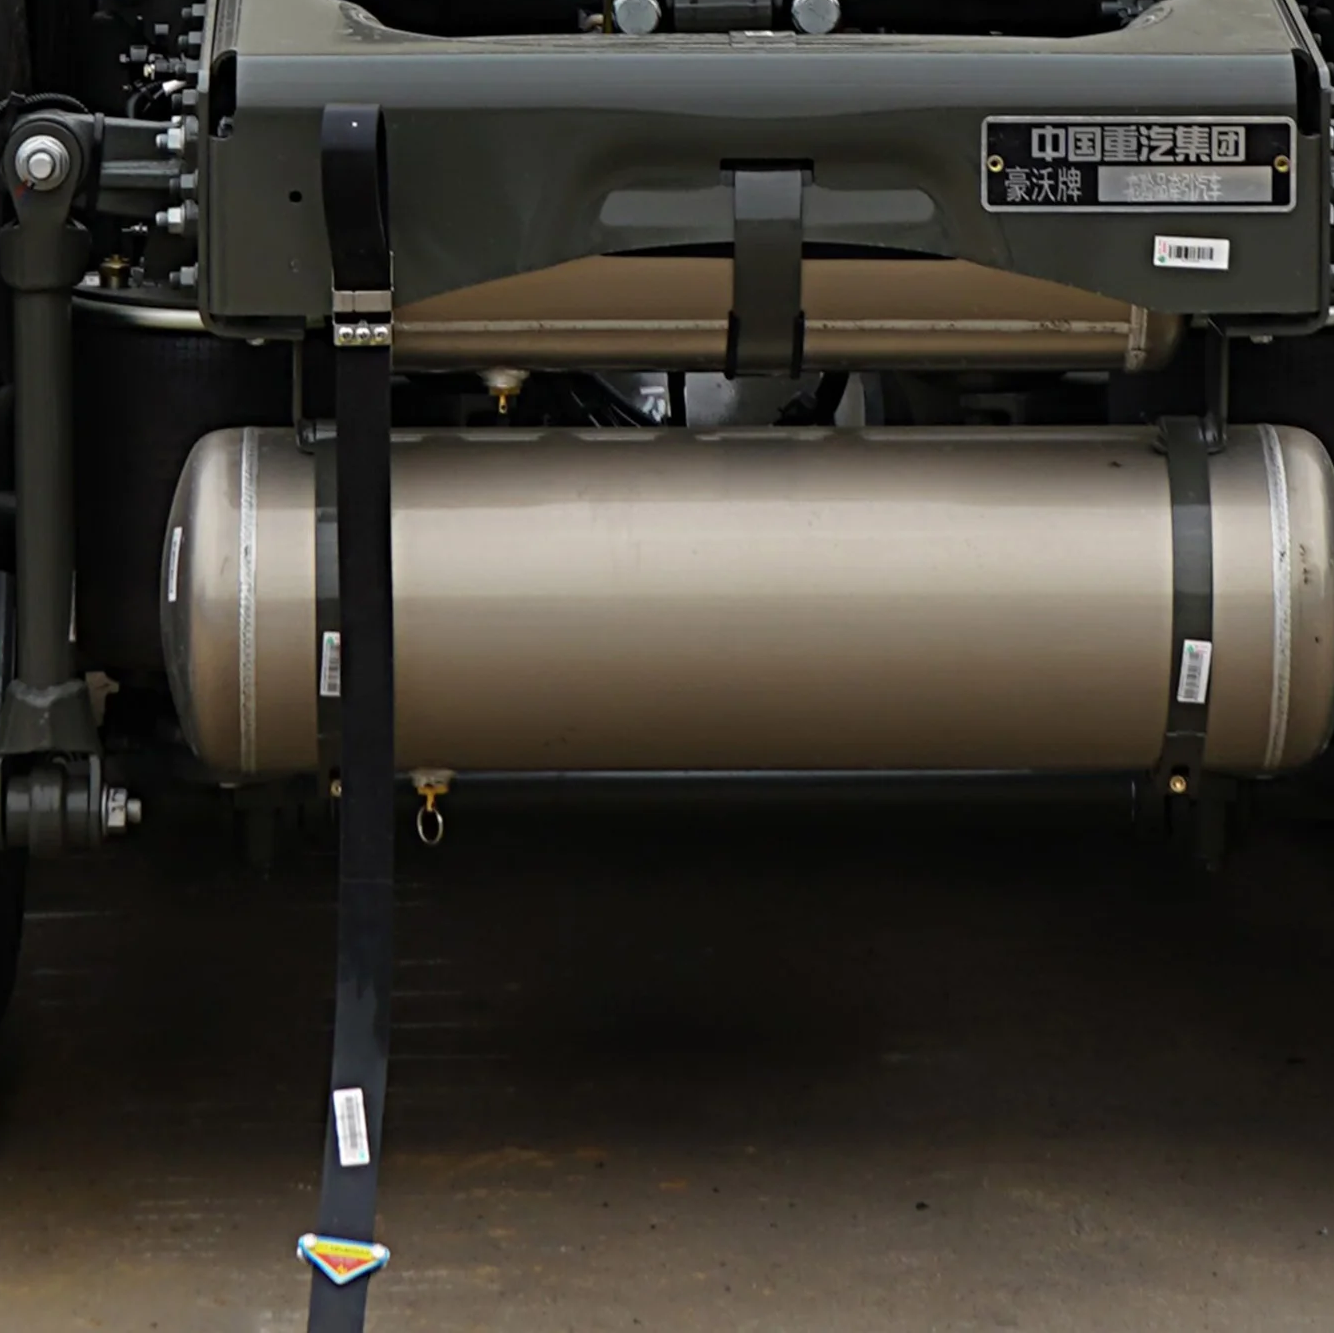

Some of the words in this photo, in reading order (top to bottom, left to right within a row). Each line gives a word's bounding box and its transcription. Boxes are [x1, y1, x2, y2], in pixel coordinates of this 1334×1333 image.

[1031, 125, 1246, 162] 中国重汽集团
[1004, 166, 1083, 203] 豪沃牌
